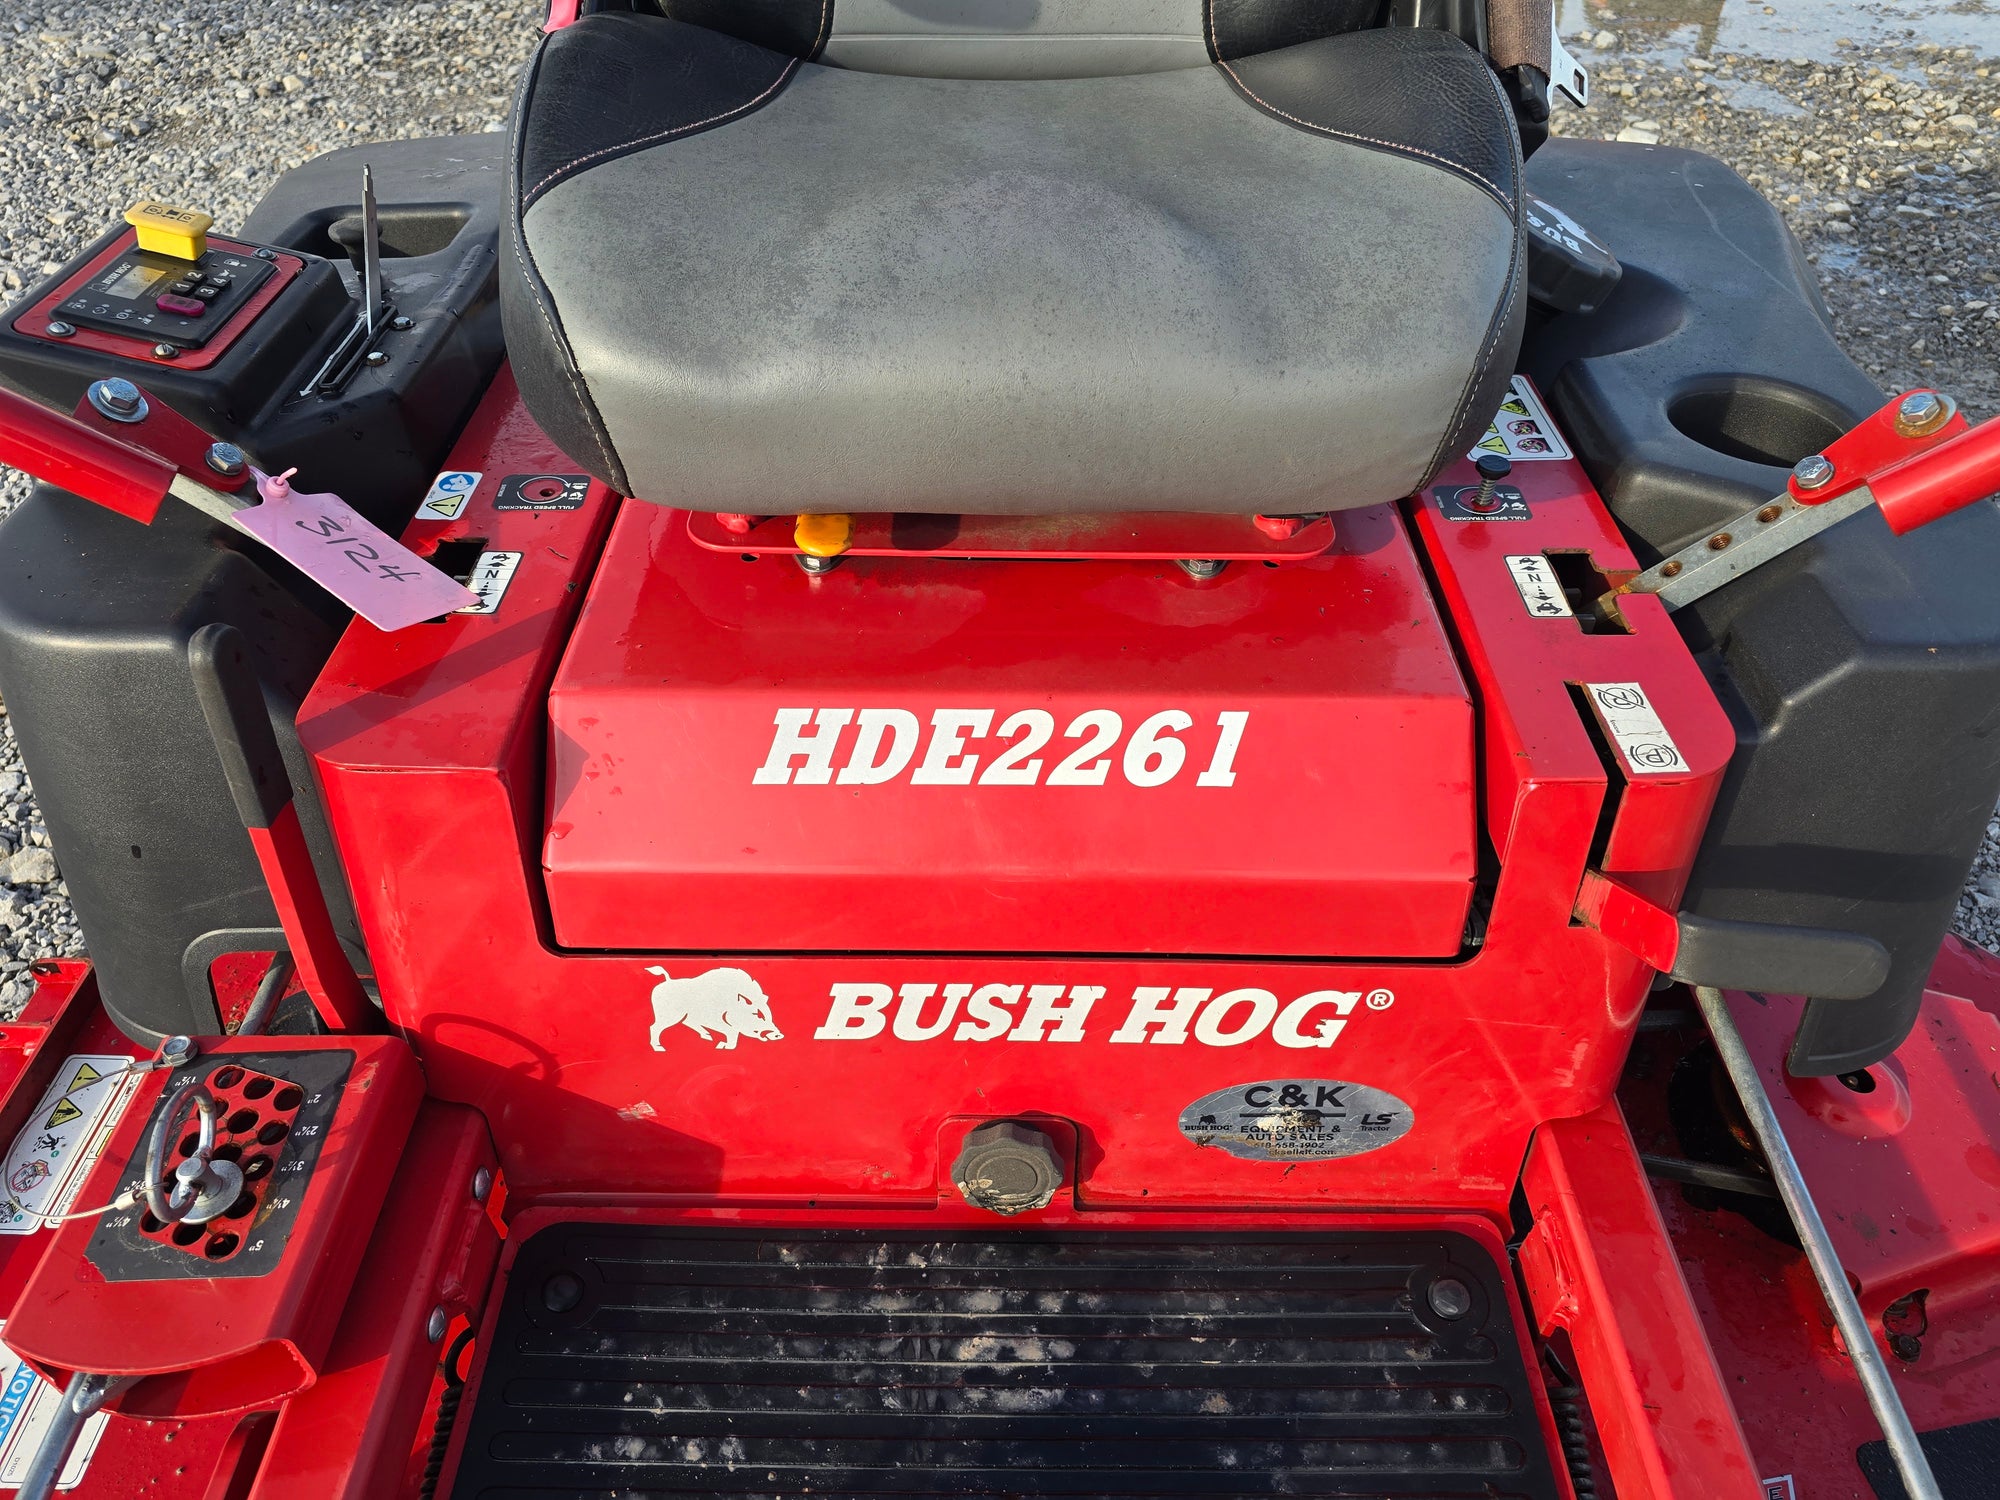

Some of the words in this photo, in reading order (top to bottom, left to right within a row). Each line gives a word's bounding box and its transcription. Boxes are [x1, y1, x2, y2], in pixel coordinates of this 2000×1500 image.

[1527, 210, 1583, 255] BUS
[176, 282, 190, 290] 1
[188, 271, 202, 280] 2
[200, 287, 214, 296] 3
[213, 276, 227, 285] 4
[485, 569, 499, 579] N
[1527, 573, 1542, 582] N
[751, 707, 1250, 788] HDE2261
[814, 982, 1107, 1043] BUSH
[1361, 1113, 1400, 1125] LS
[1332, 1125, 1341, 1133] &
[1245, 1133, 1285, 1141] AUTO
[1289, 1133, 1335, 1141] SALES
